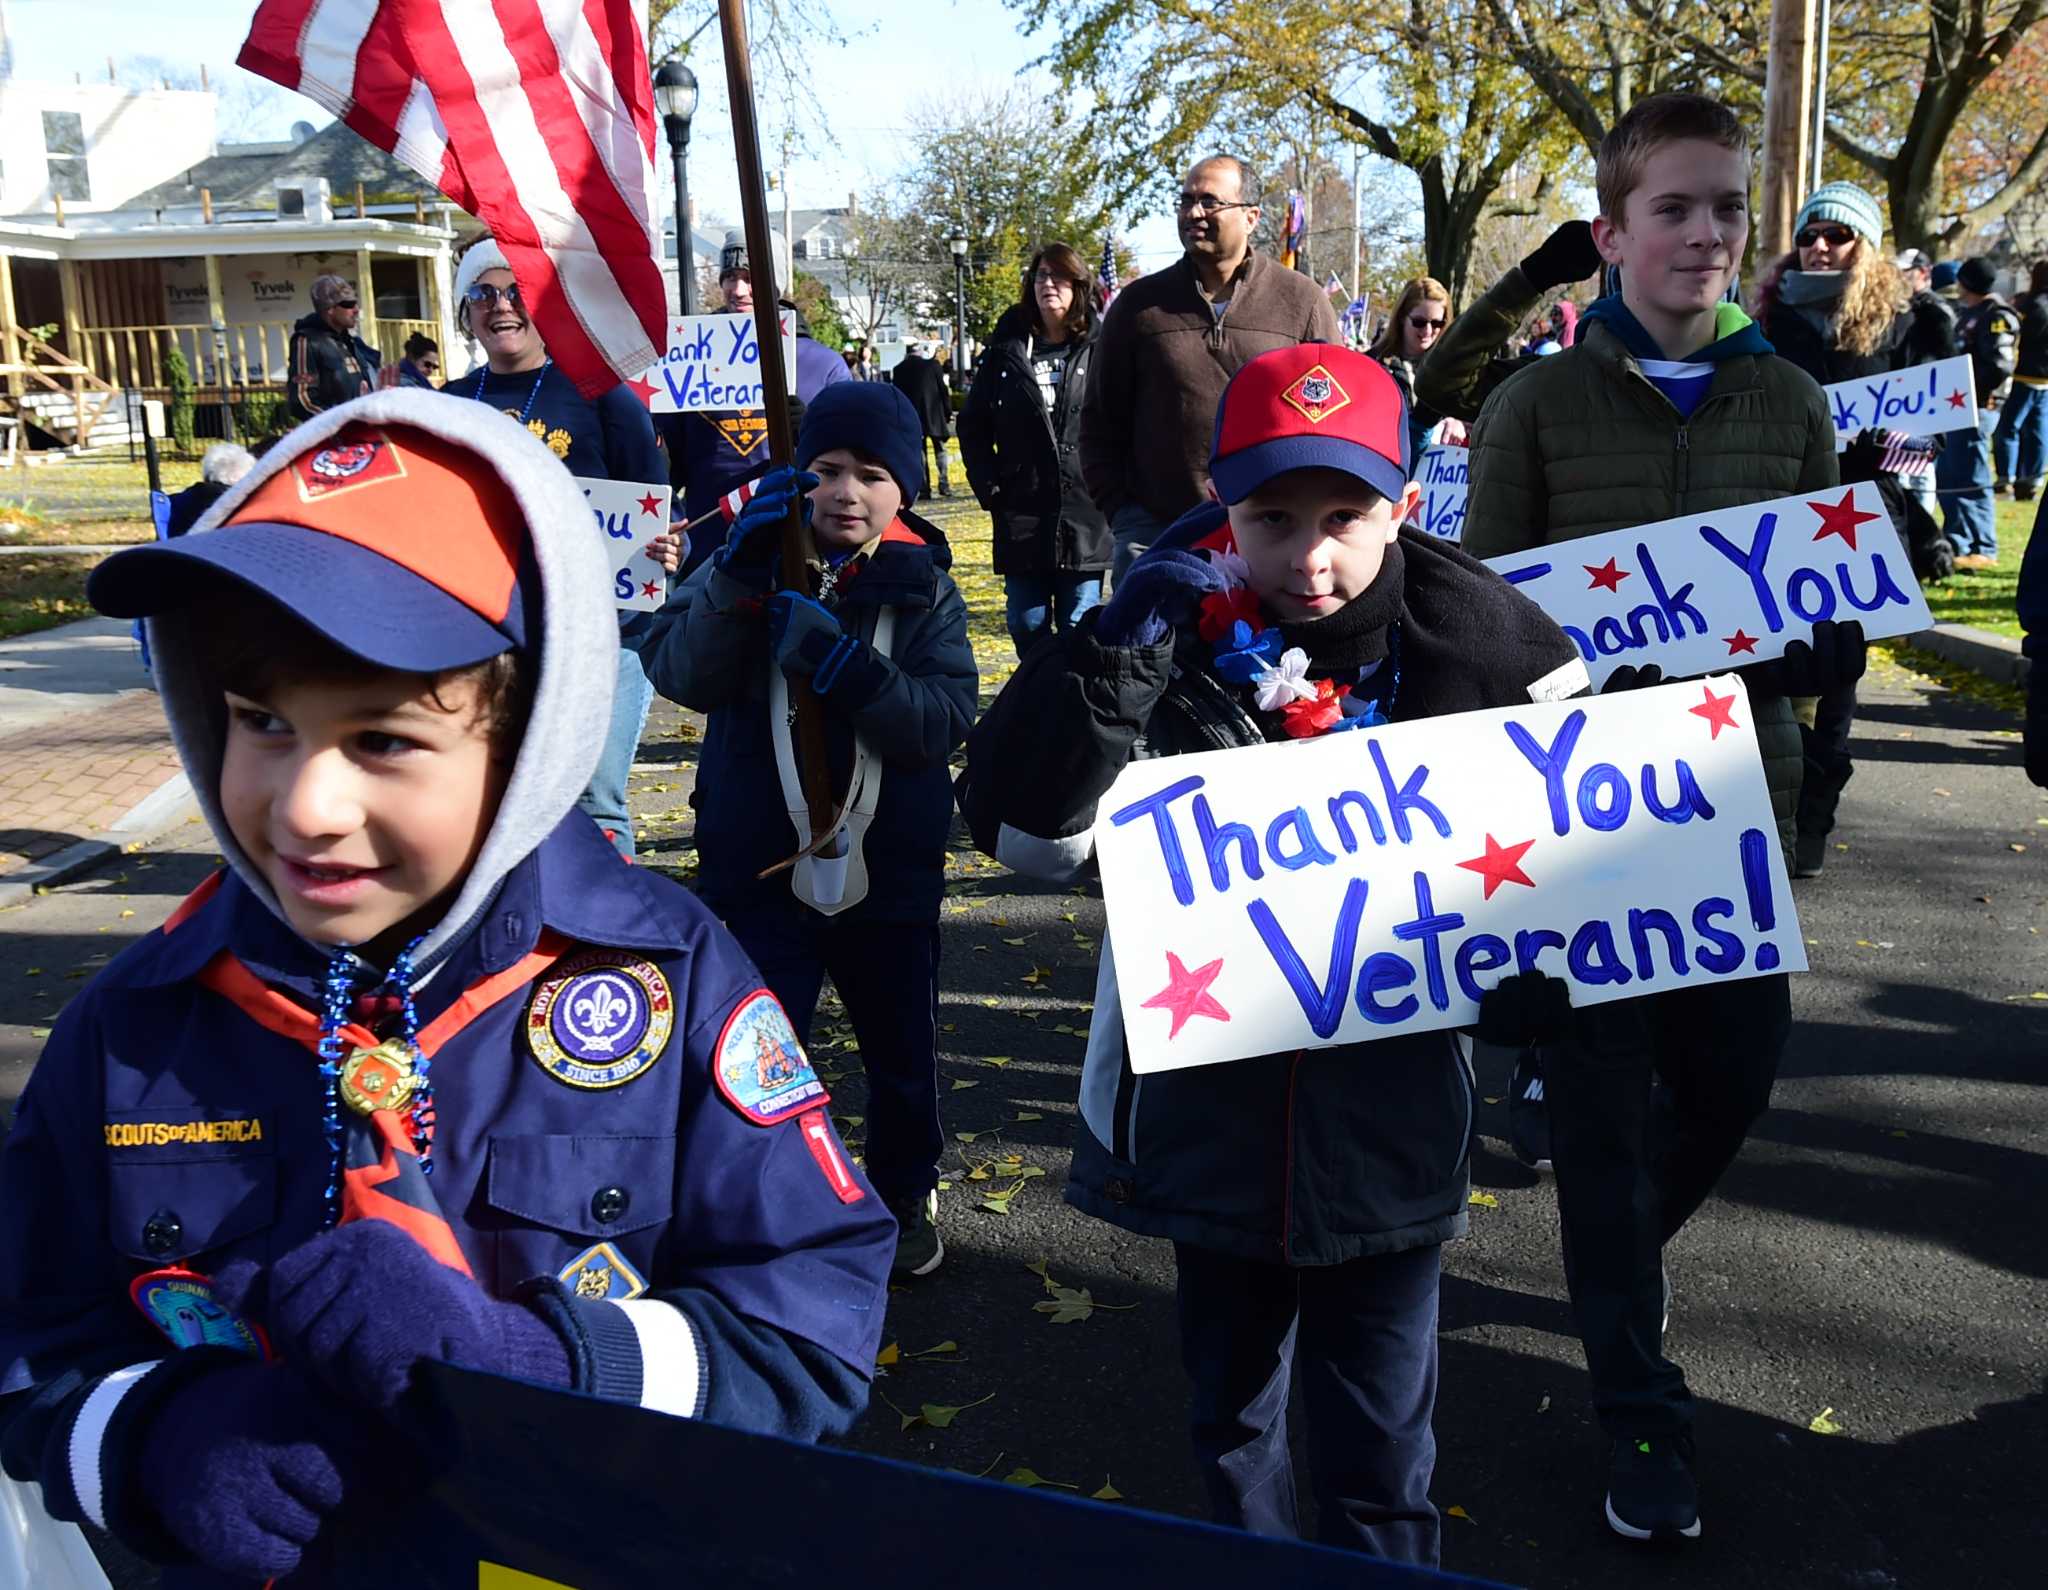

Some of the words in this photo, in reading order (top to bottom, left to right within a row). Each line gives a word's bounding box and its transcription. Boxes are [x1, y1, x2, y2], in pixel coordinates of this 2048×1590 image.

[251, 279, 295, 295] Tyvek
[728, 319, 760, 365] Yo
[1867, 367, 1937, 426] You!
[1424, 450, 1472, 485] Than
[1501, 543, 1708, 662] ank
[1699, 512, 1910, 634] You
[1110, 738, 1452, 906] Thank
[1503, 708, 1717, 837] You
[1245, 828, 1781, 1039] Veterans!
[565, 1064, 609, 1083] SINCE
[612, 1057, 641, 1079] 1910
[184, 1119, 263, 1144] AMERICA
[808, 1125, 848, 1188] 1
